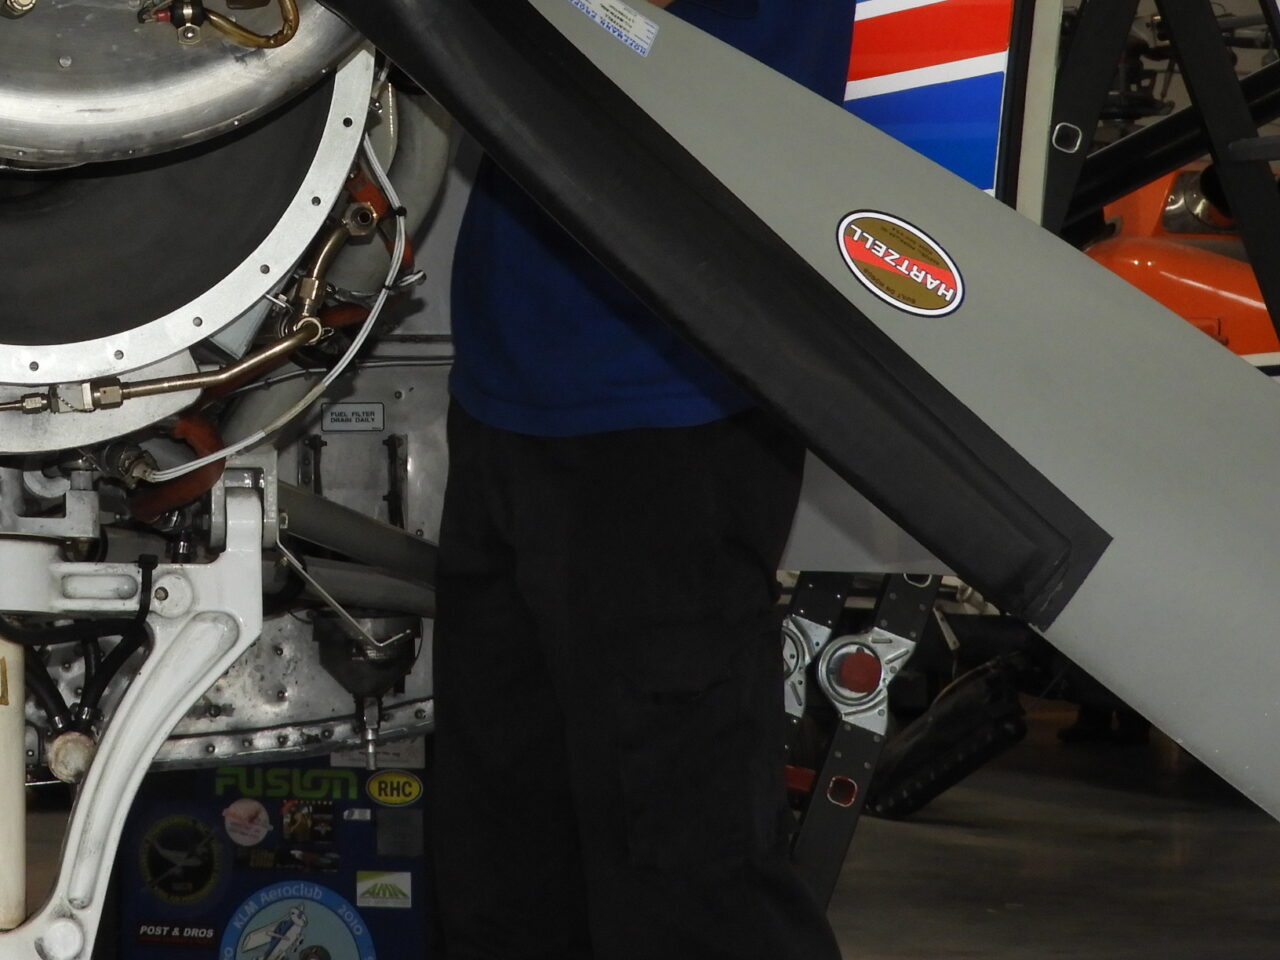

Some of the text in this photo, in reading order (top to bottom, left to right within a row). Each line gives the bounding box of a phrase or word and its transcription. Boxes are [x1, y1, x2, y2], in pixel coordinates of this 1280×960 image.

[599, 16, 649, 56] HOFFMANN
[850, 224, 955, 302] HARTZELL
[215, 767, 360, 799] FUSION
[378, 780, 413, 798] RHC
[233, 882, 364, 936] KLM Aeroclub 2010
[139, 924, 215, 938] POST & DROS
